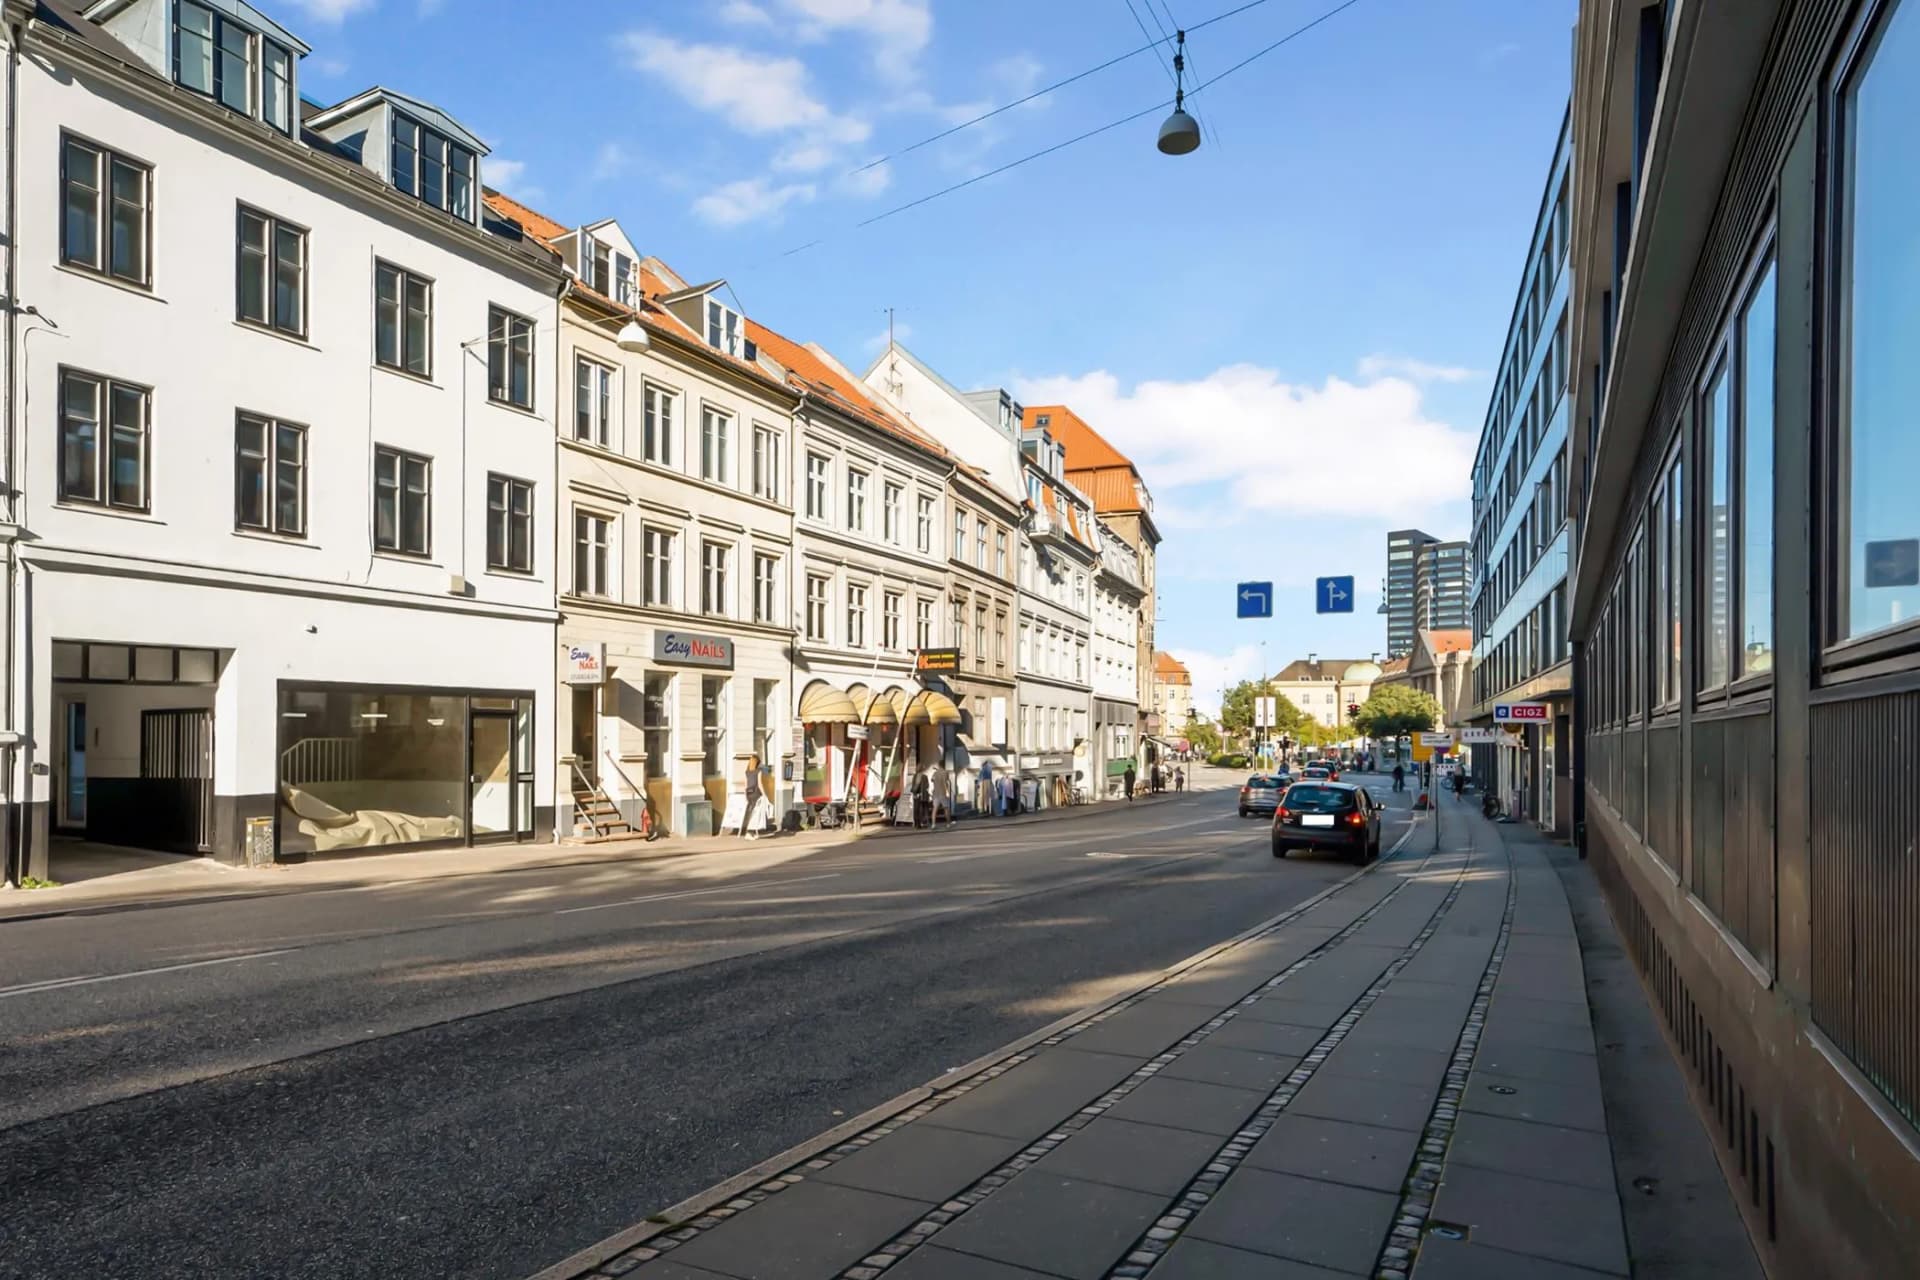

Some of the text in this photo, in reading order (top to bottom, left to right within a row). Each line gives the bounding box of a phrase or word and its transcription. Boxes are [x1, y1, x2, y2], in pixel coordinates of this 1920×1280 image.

[570, 646, 590, 661] Easy
[664, 634, 690, 658] Easy
[1498, 708, 1543, 717] e CIGZ
